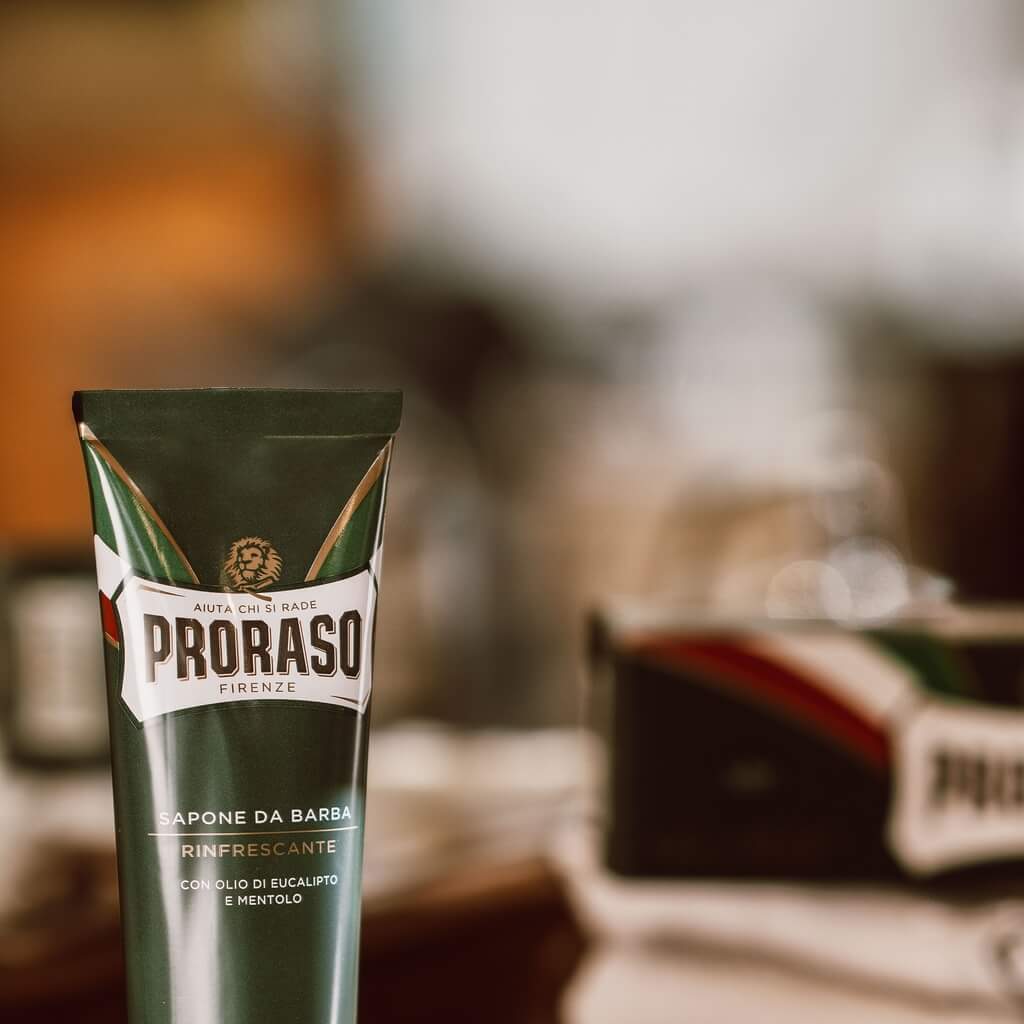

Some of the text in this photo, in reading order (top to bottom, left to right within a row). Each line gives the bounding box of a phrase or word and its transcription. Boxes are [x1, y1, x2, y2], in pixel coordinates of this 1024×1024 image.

[193, 600, 318, 614] AIUTA CHI SI RADE
[143, 609, 363, 683] PRORASO
[219, 682, 297, 694] FIRENZE
[158, 805, 352, 826] SAPONE DA BARBA
[180, 839, 337, 859] RINFRESCANTE
[180, 874, 339, 891] CON OLIO DI EUCALIPTO
[225, 893, 302, 906] E MENTOLO
